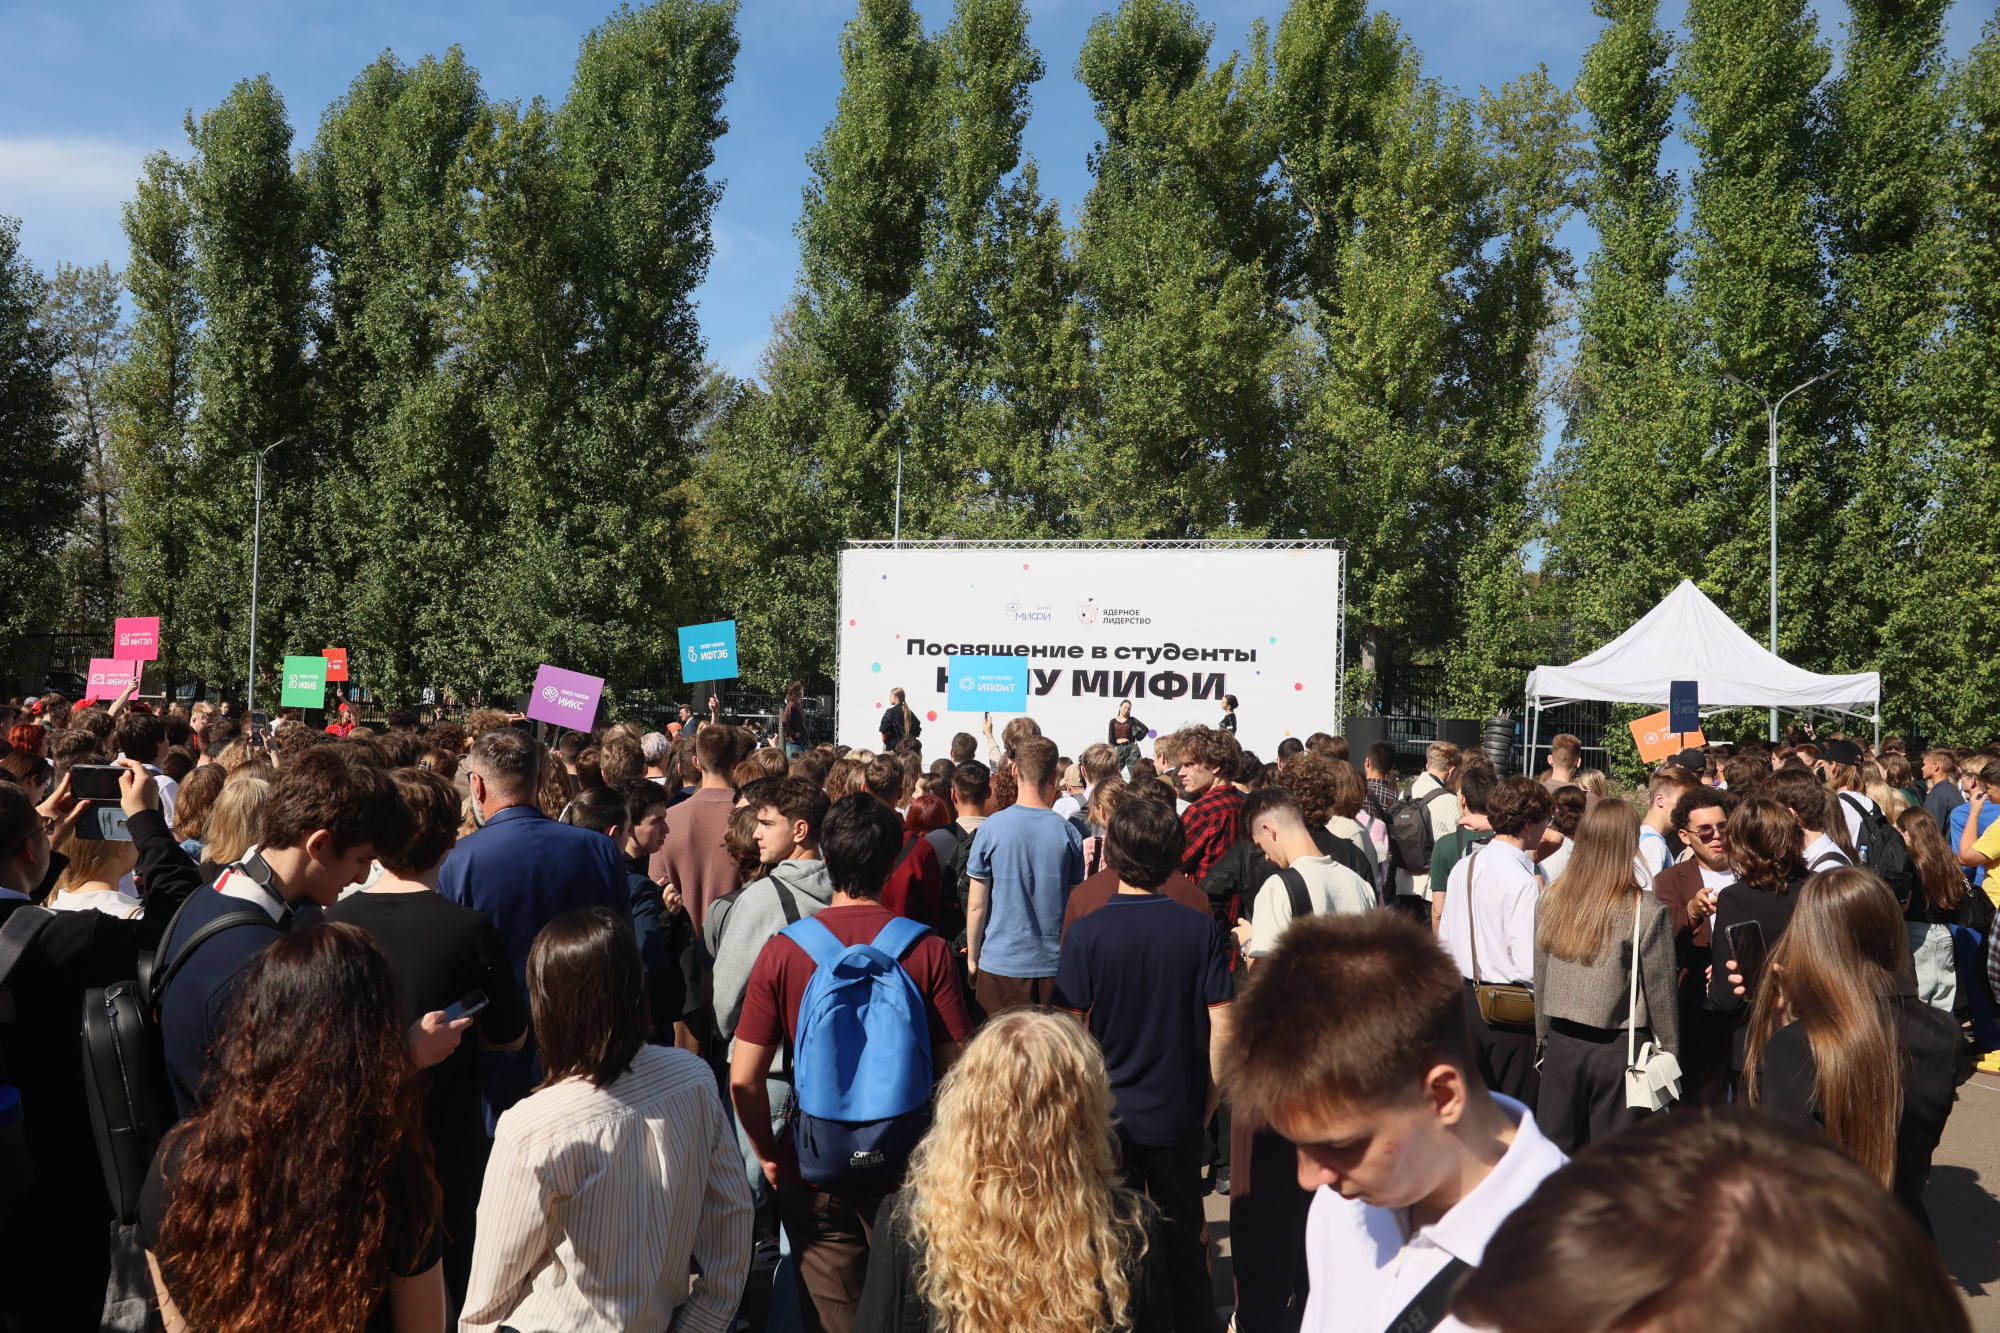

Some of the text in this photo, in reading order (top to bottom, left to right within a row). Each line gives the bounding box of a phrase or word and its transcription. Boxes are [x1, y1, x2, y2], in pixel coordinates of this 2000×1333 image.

[1102, 617, 1152, 625] ЛИДЕРСТВО
[130, 637, 153, 646] ИНТЭЛ
[700, 649, 729, 661] ИФТЭБ
[907, 639, 1256, 664] Посвящение в студенты
[106, 678, 132, 687] ФБИУ
[298, 681, 318, 690] ИФИБ
[978, 683, 1017, 693] ИЯФиТ
[1072, 669, 1227, 700] МИФИ
[557, 696, 585, 711] ИИКС
[850, 1153, 884, 1166] CINEMA
